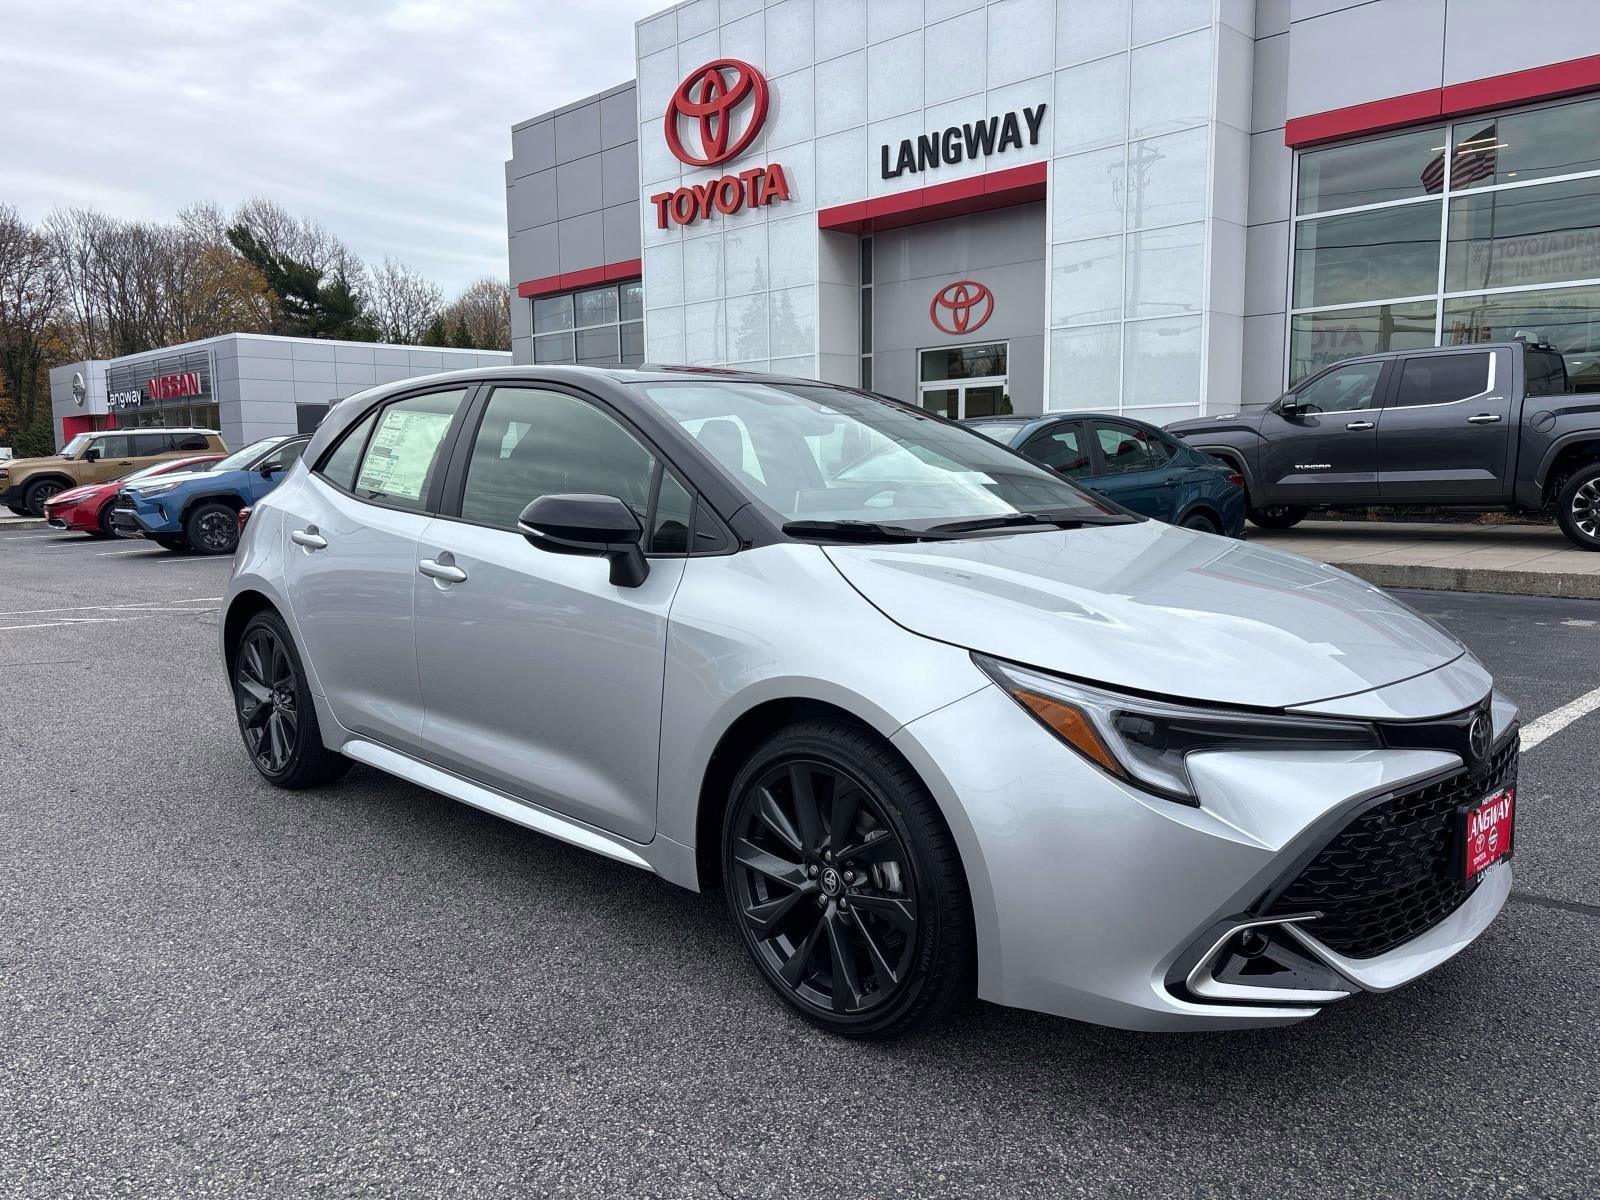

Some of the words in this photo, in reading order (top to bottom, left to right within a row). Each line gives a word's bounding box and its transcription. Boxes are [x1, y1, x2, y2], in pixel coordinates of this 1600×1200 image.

[881, 103, 1047, 179] LANGWAY
[651, 163, 790, 229] TOYOTA
[1498, 236, 1559, 258] TOYOTA
[106, 389, 141, 408] Langway
[147, 373, 200, 400] NISSAN
[1468, 797, 1511, 842] LANGWAY
[919, 910, 935, 972] YOKOHAMA
